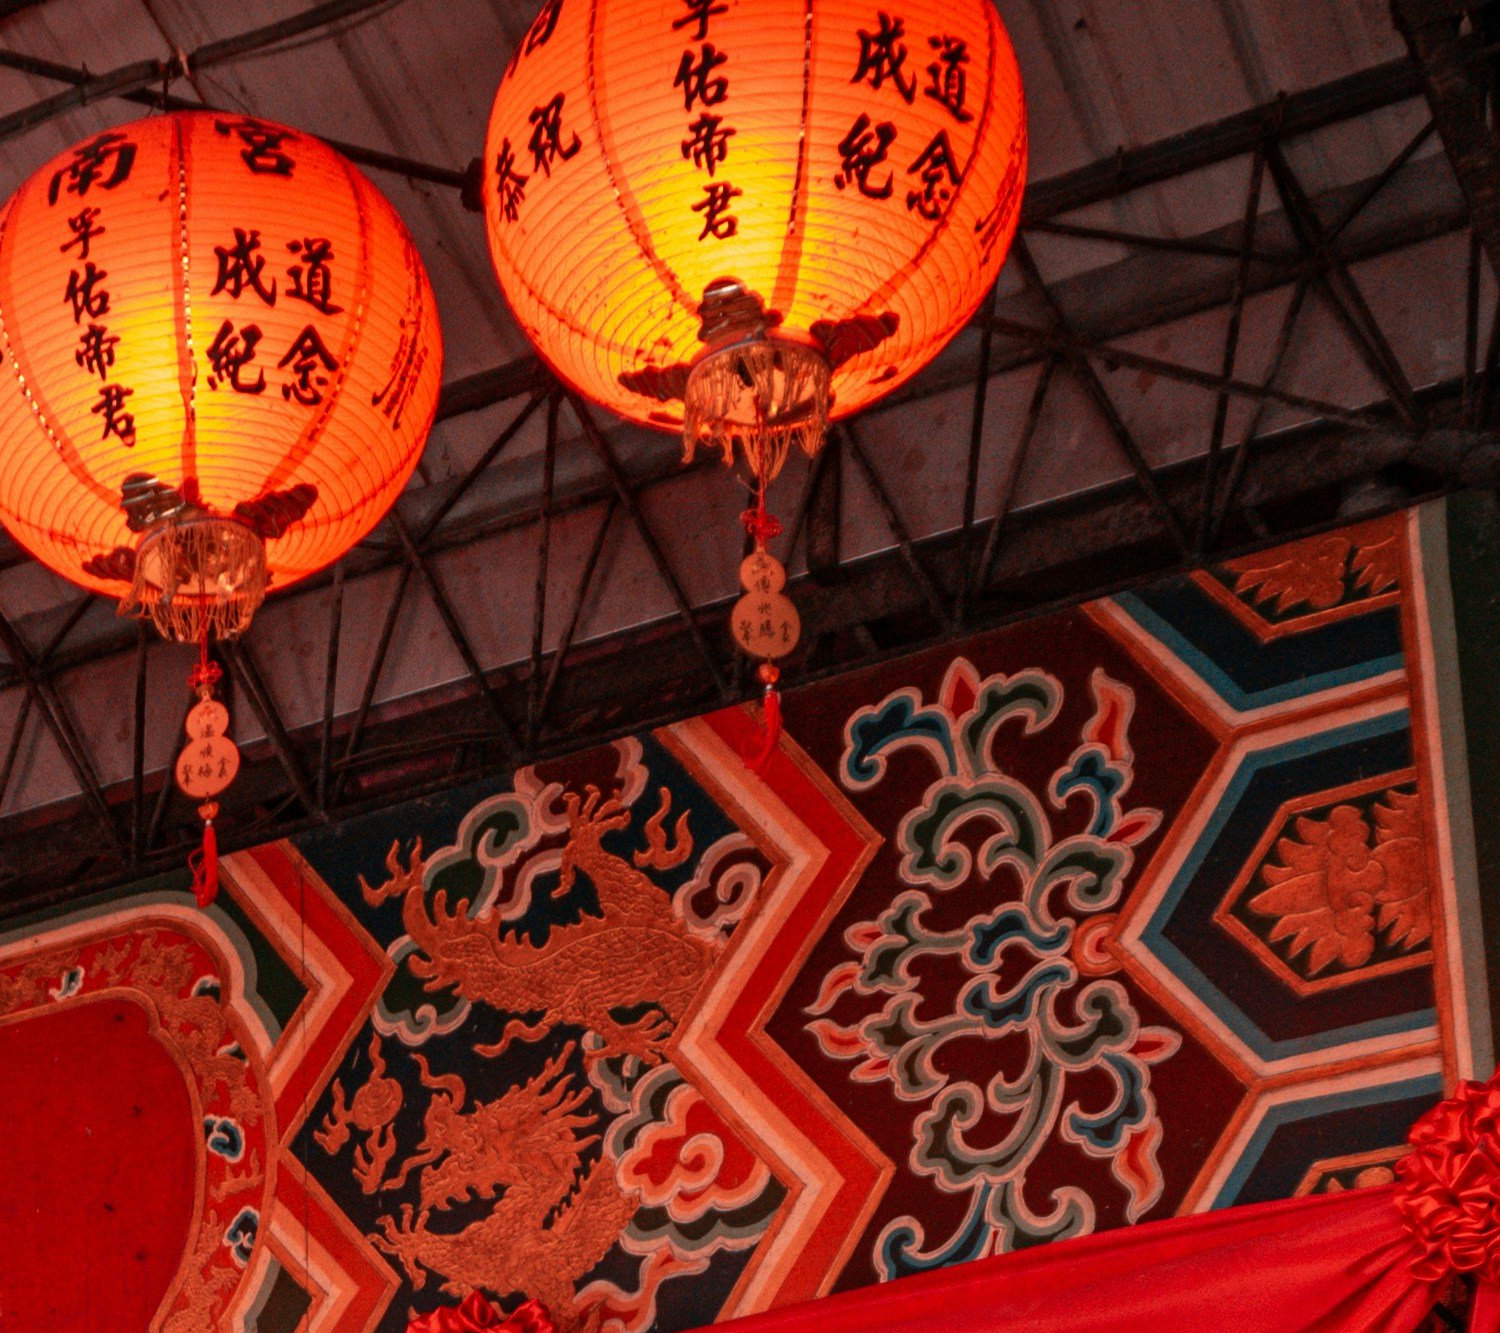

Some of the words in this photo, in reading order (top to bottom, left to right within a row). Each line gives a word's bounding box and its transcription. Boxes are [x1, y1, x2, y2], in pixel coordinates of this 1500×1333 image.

[852, 17, 975, 125] 成道
[493, 93, 583, 224] 恭祝
[834, 112, 965, 224] 紀念
[57, 206, 139, 447] 孚佑帝君
[209, 228, 342, 316] 成道
[203, 318, 341, 404] 紀念
